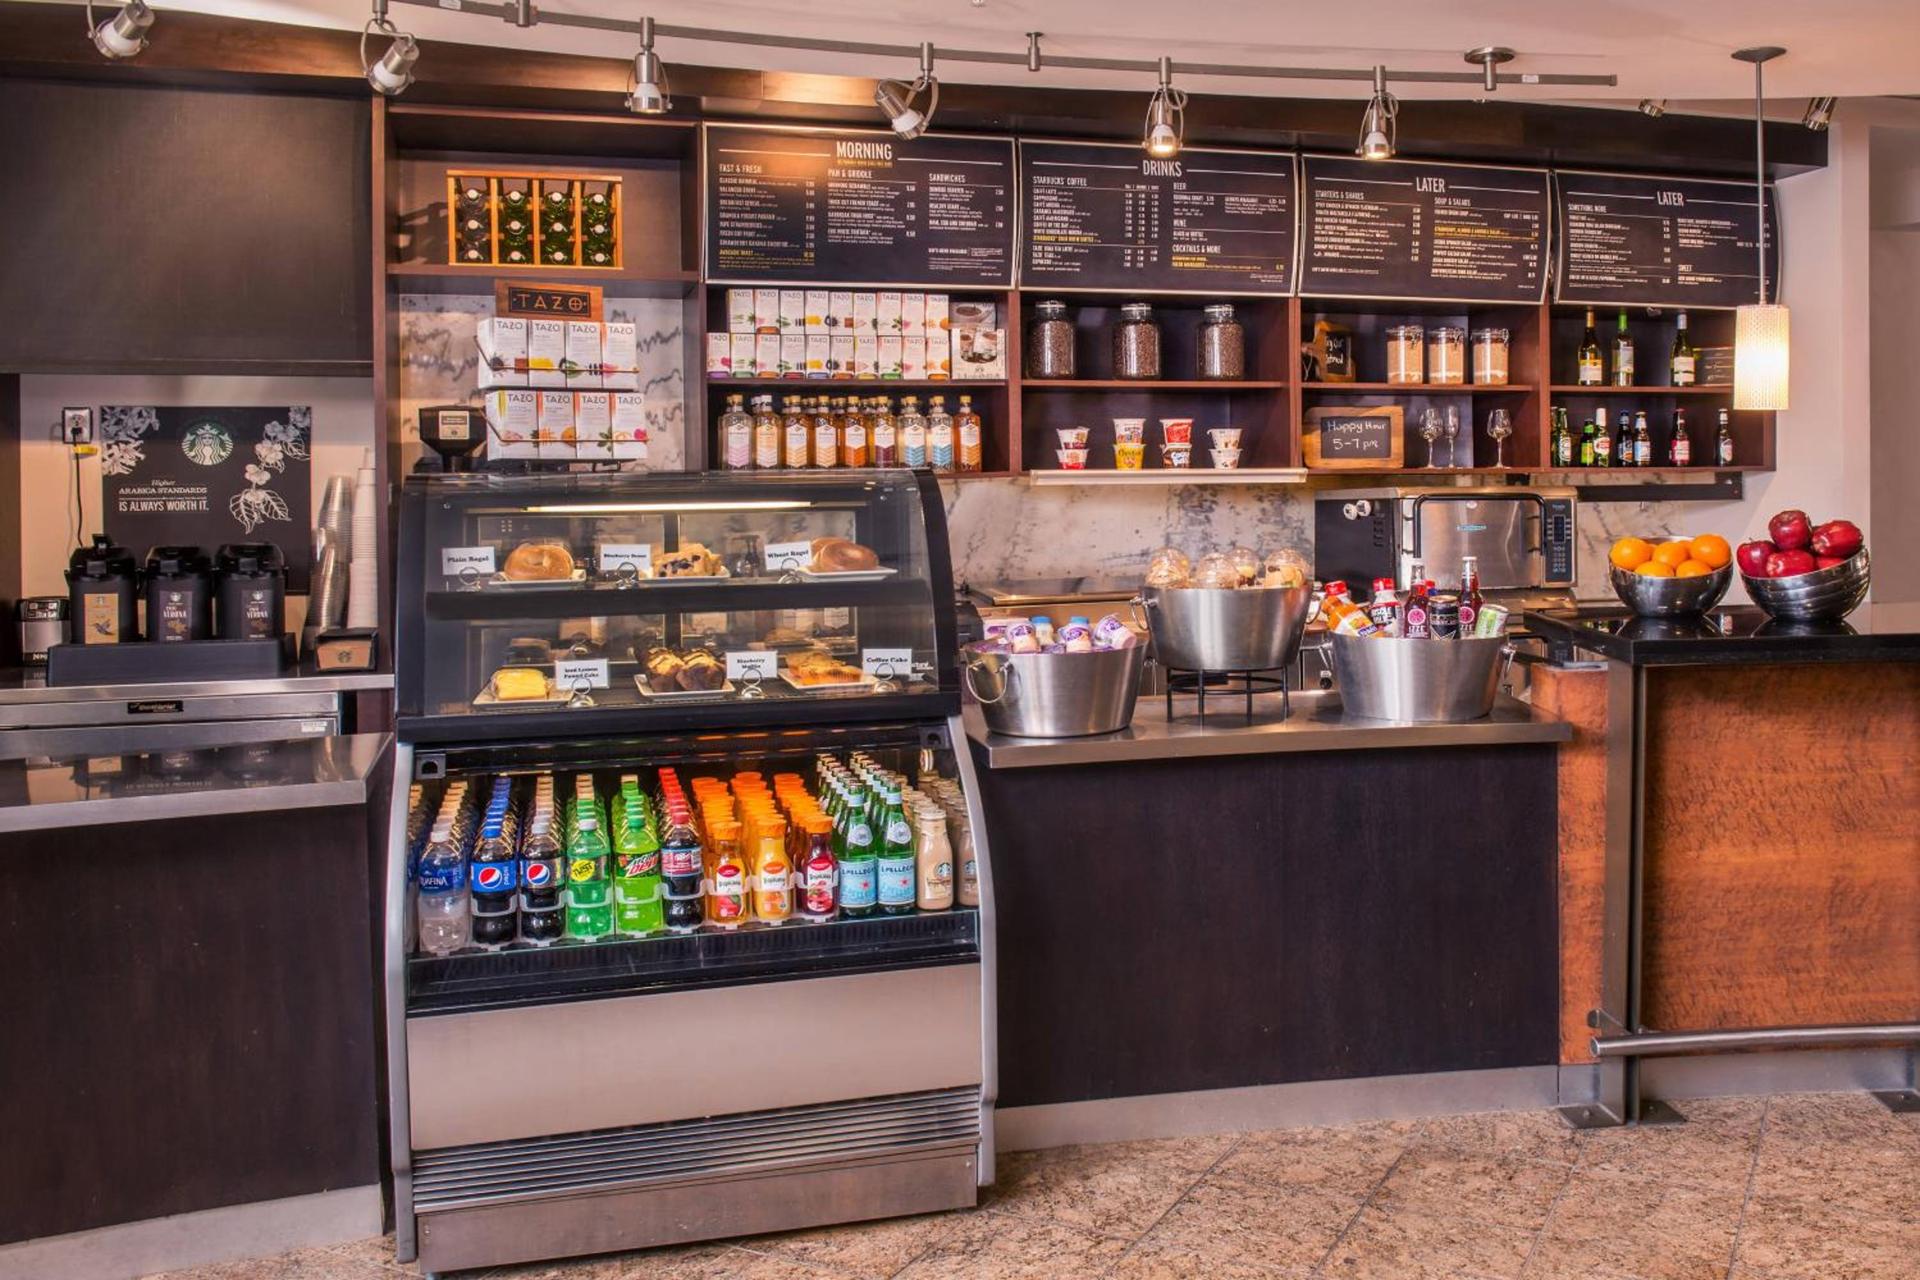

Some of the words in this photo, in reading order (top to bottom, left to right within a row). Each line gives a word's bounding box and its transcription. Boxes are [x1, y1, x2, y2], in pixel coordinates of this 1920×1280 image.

[836, 141, 892, 160] MORNING
[719, 164, 733, 173] FAST
[828, 168, 840, 178] PAN
[1143, 160, 1182, 177] DRINKS
[929, 173, 966, 183] SANDWICHES
[1416, 176, 1445, 193] LATER
[1657, 190, 1684, 206] LATER
[516, 293, 584, 312] TAZO
[497, 320, 523, 330] TAZO
[535, 322, 561, 332] TAZO
[571, 324, 597, 334] TAZO
[609, 326, 633, 335] TAZO
[508, 393, 534, 403] TAZO
[545, 394, 571, 404] TAZO
[582, 395, 608, 404] TAZO
[618, 396, 642, 405] TAZO
[1327, 420, 1363, 434] Happy
[1365, 420, 1386, 430] Hour
[1332, 438, 1360, 450] 5-7
[151, 479, 176, 487] Higher
[118, 487, 157, 495] ARABICA
[118, 501, 128, 511] IS
[129, 501, 165, 511] ALWAYS
[166, 500, 197, 511] WORTH
[199, 500, 210, 511] IT.
[767, 551, 789, 559] Wheat
[1408, 625, 1424, 633] IZZE
